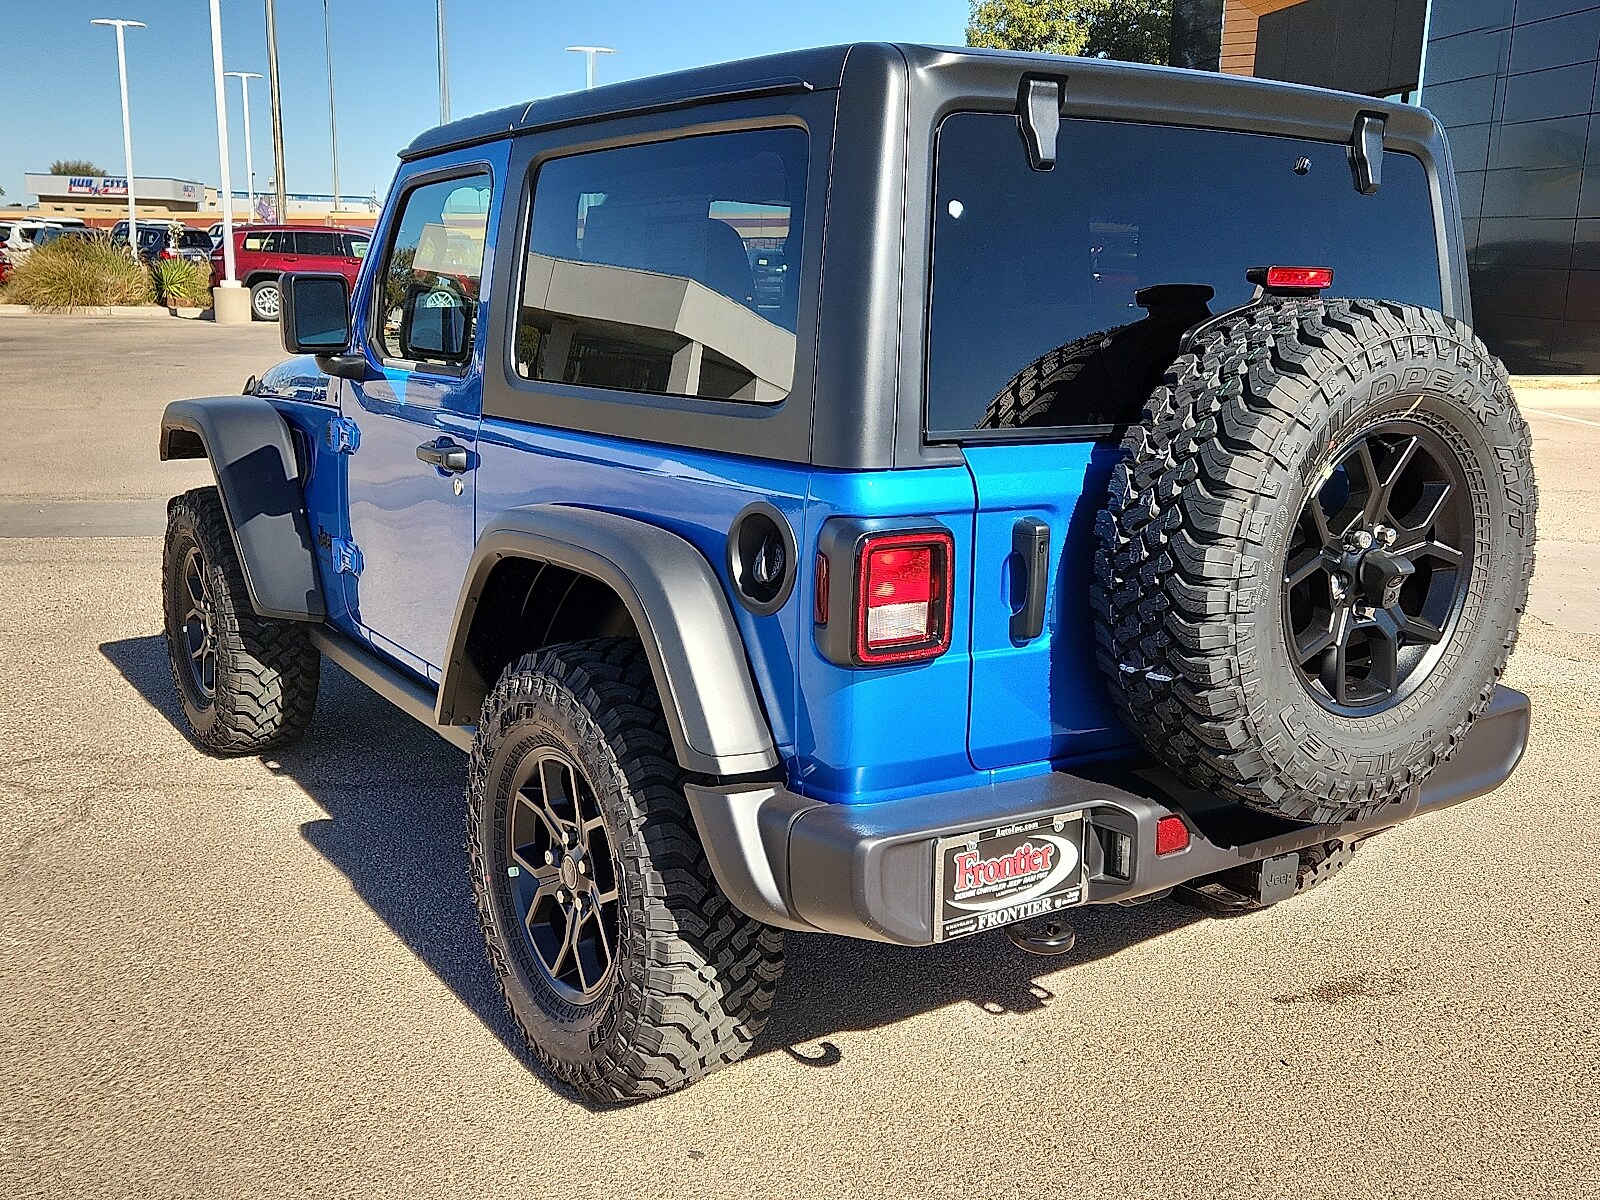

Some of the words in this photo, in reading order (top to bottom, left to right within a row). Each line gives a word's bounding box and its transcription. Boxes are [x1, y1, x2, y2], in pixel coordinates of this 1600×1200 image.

[69, 178, 93, 187] HUB
[1299, 366, 1498, 487] WILDPEAK
[956, 845, 1053, 890] Frontier
[978, 898, 1052, 930] FRONTIER
